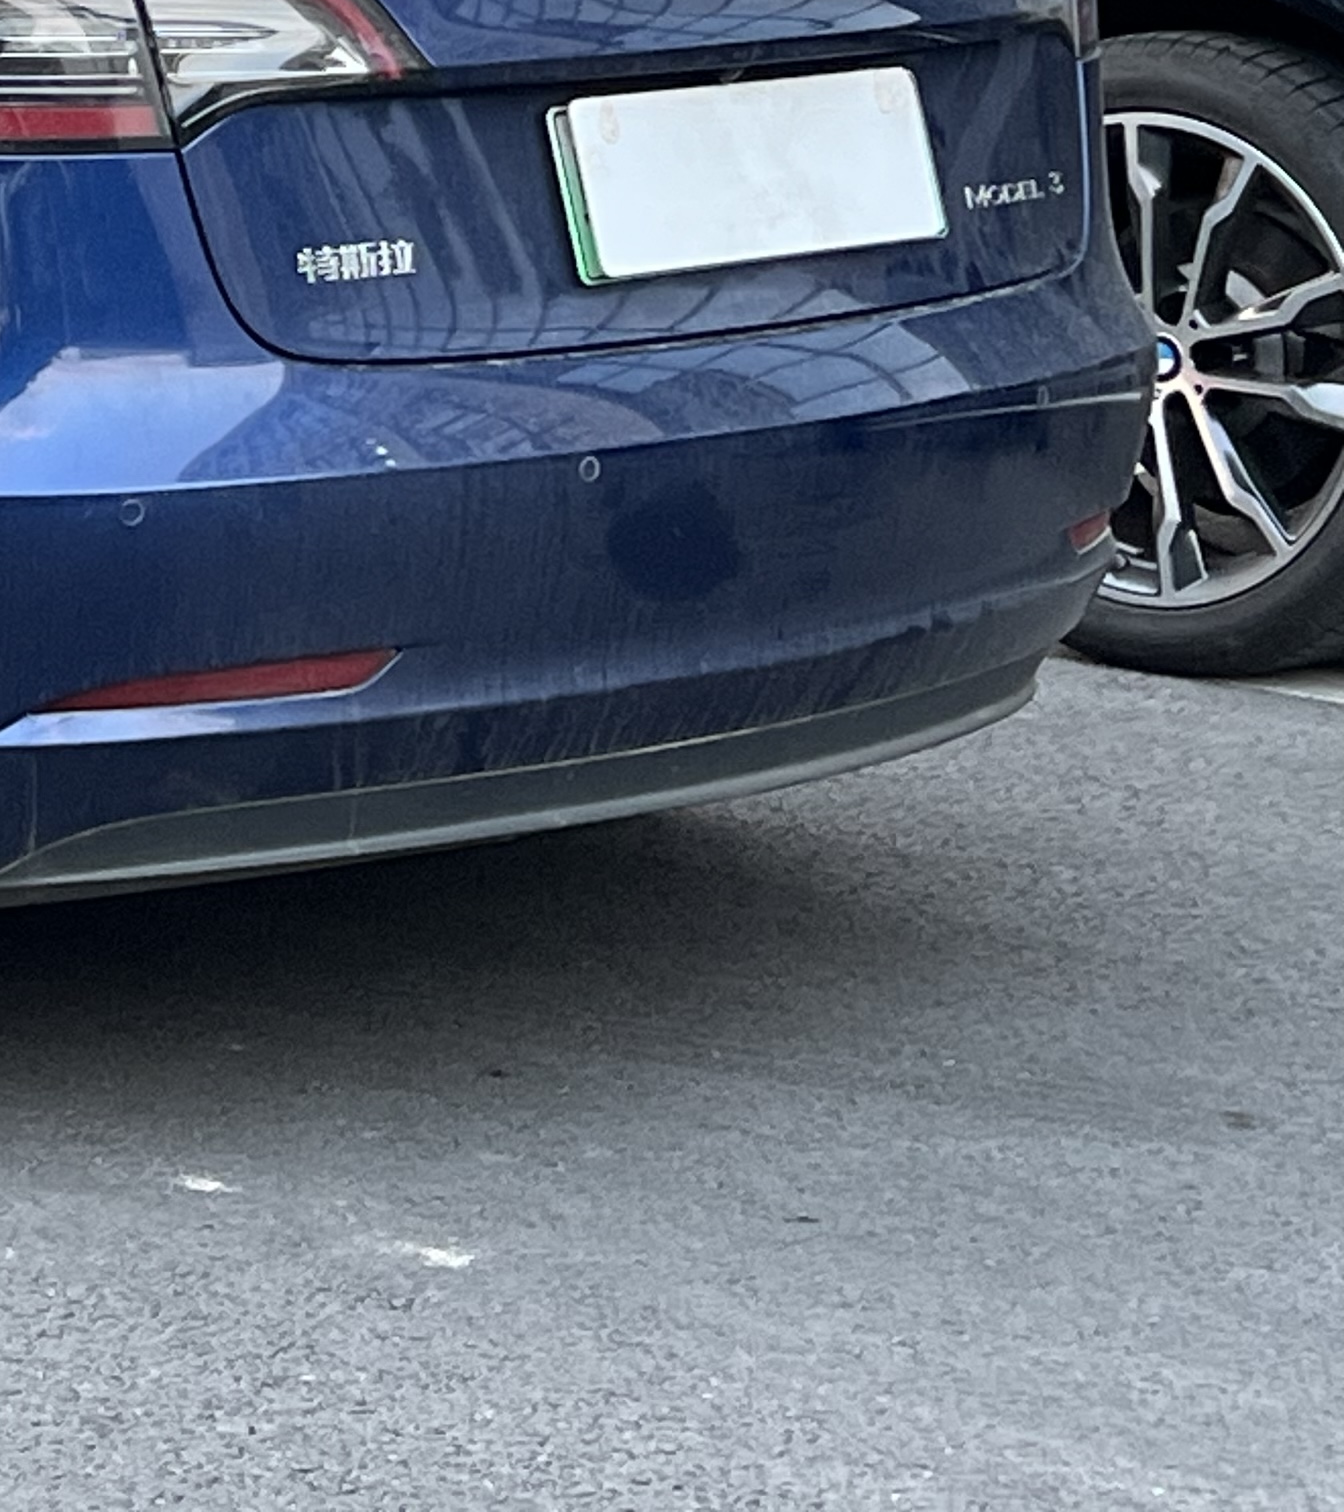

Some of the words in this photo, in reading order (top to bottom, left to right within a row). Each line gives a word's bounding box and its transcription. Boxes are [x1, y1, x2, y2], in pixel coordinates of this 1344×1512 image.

[963, 179, 1045, 210] MODEL
[296, 239, 417, 284] 特斯拉
